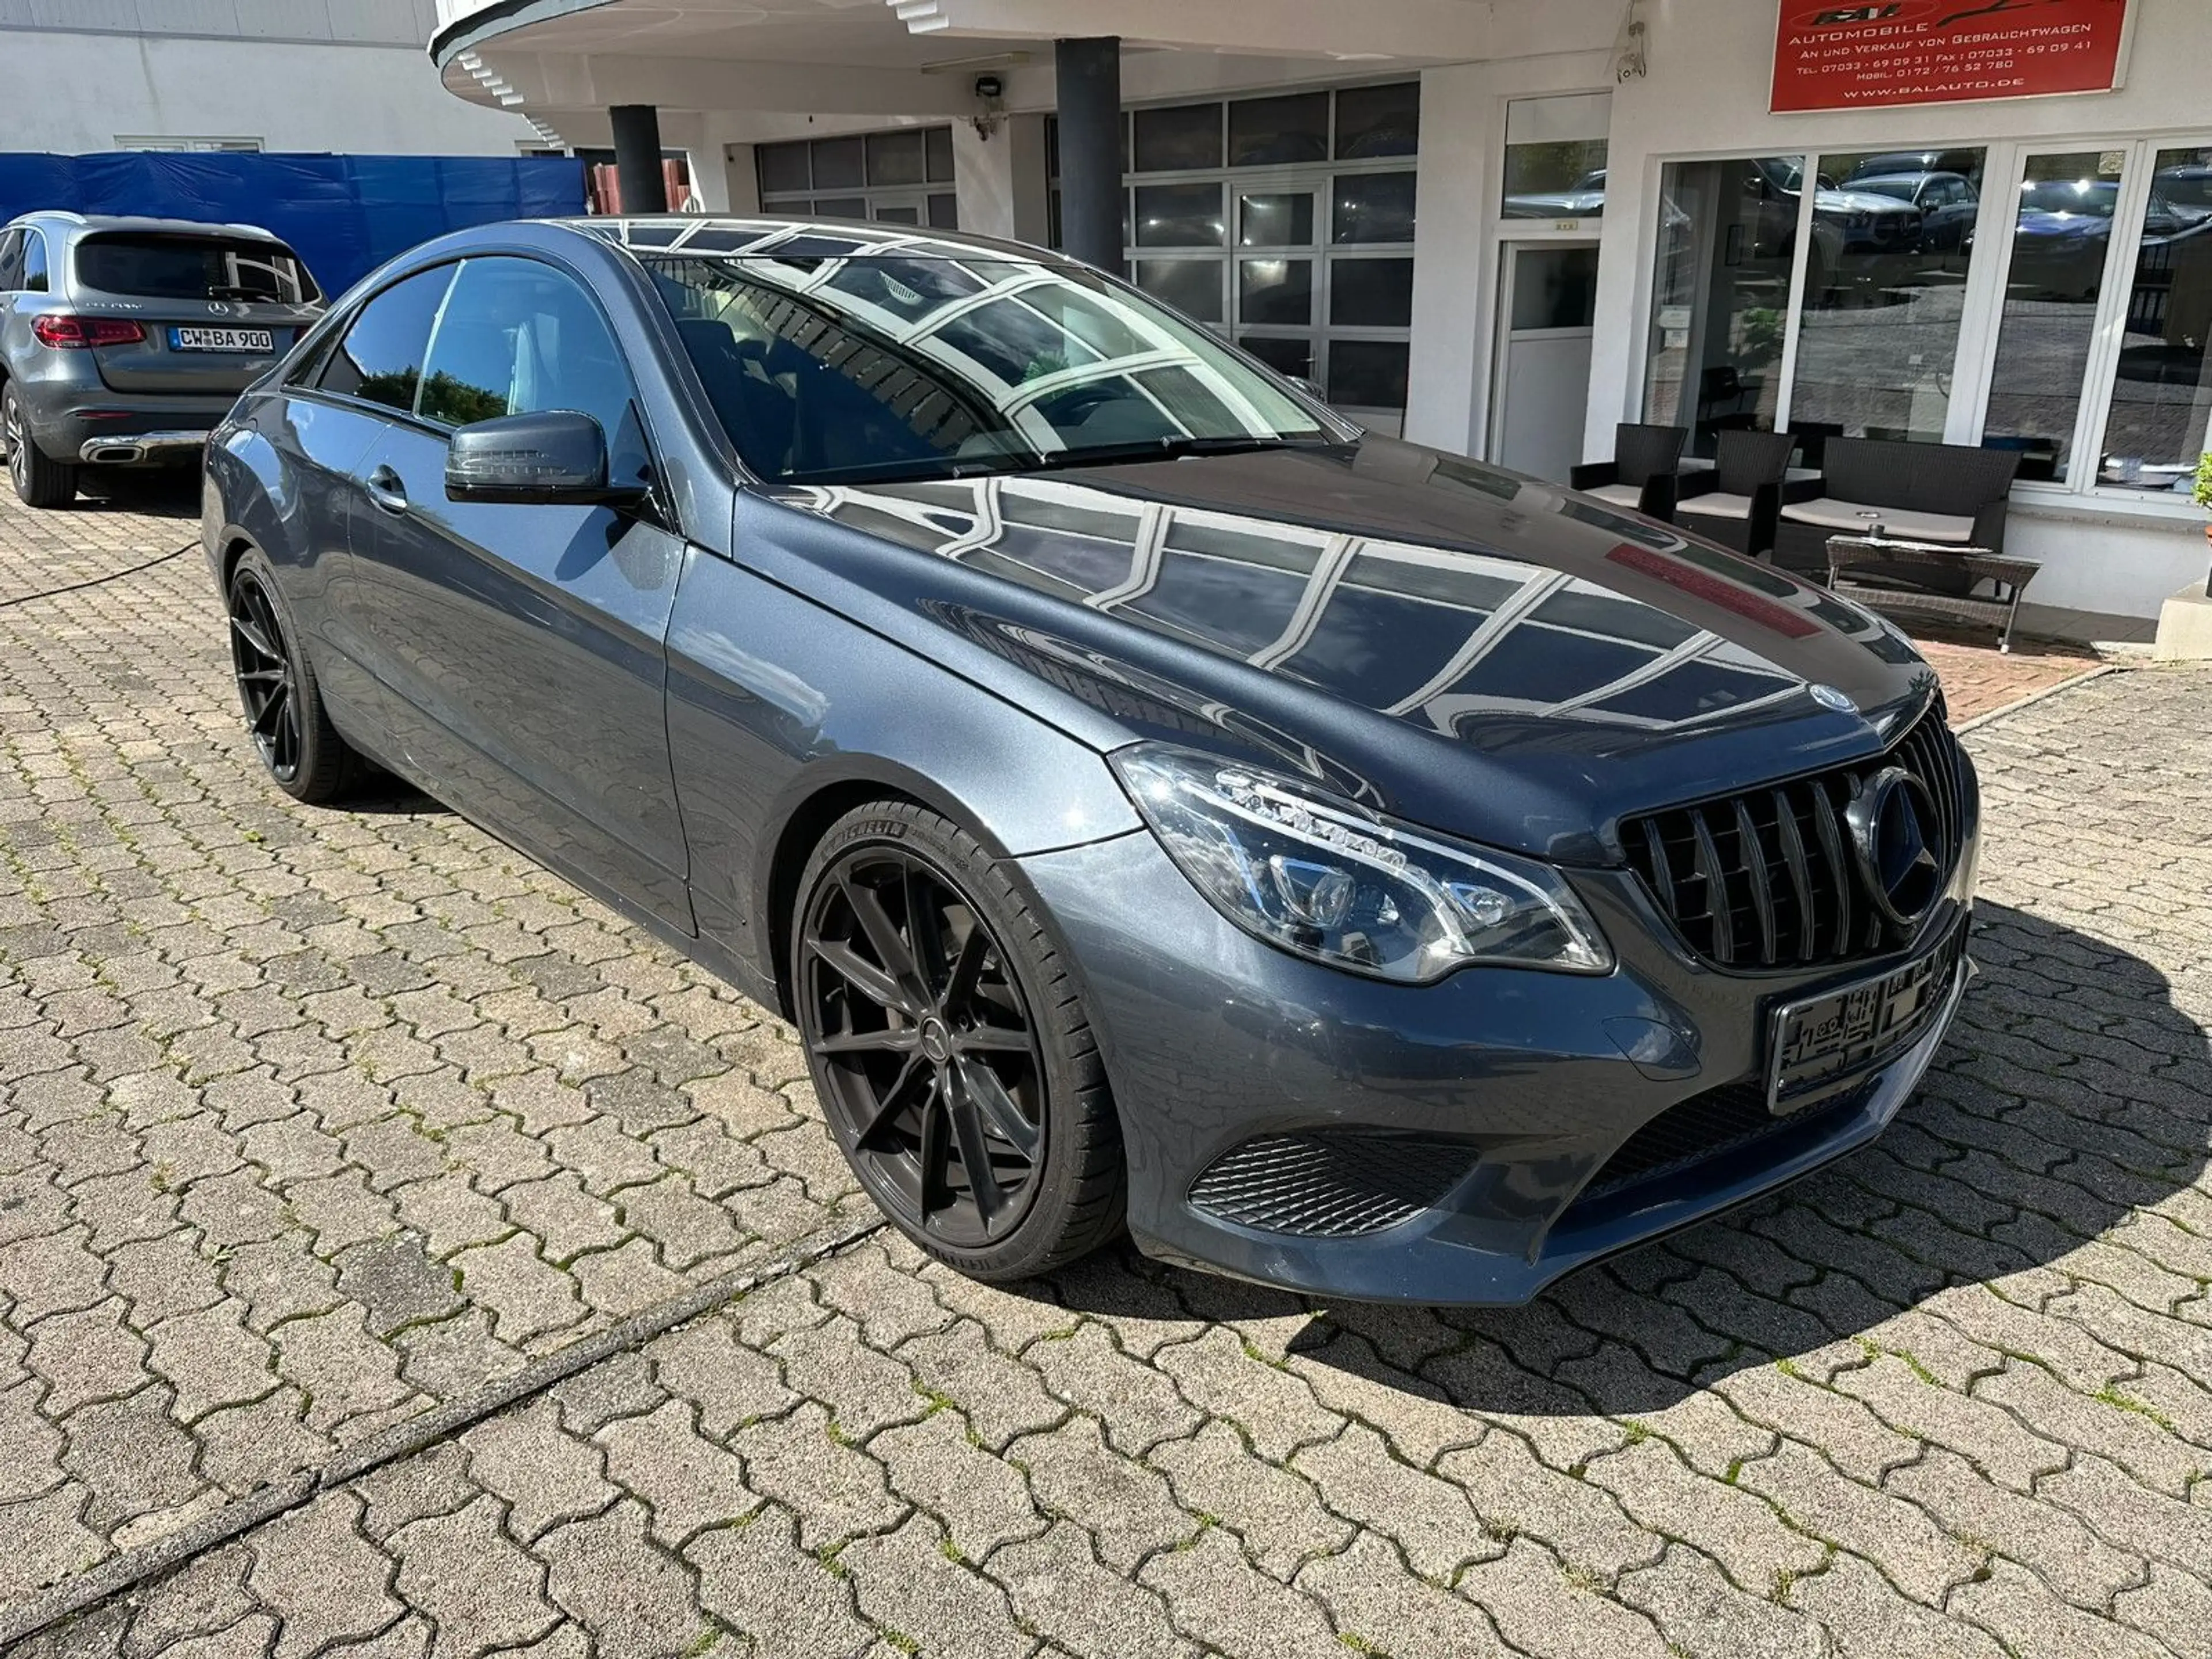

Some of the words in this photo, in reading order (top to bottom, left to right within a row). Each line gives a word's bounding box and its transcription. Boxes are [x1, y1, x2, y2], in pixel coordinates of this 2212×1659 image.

[1788, 22, 1929, 45] AUTOMOBILE
[1854, 41, 1913, 54] VERKAUF
[1952, 23, 2092, 44] GEBRAUCHTWAGEN
[1968, 48, 2013, 59] 07033
[2027, 45, 2045, 54] 69
[1896, 66, 1930, 78] 0172
[180, 329, 202, 346] CW
[212, 331, 236, 346] BA
[238, 332, 270, 347] 900
